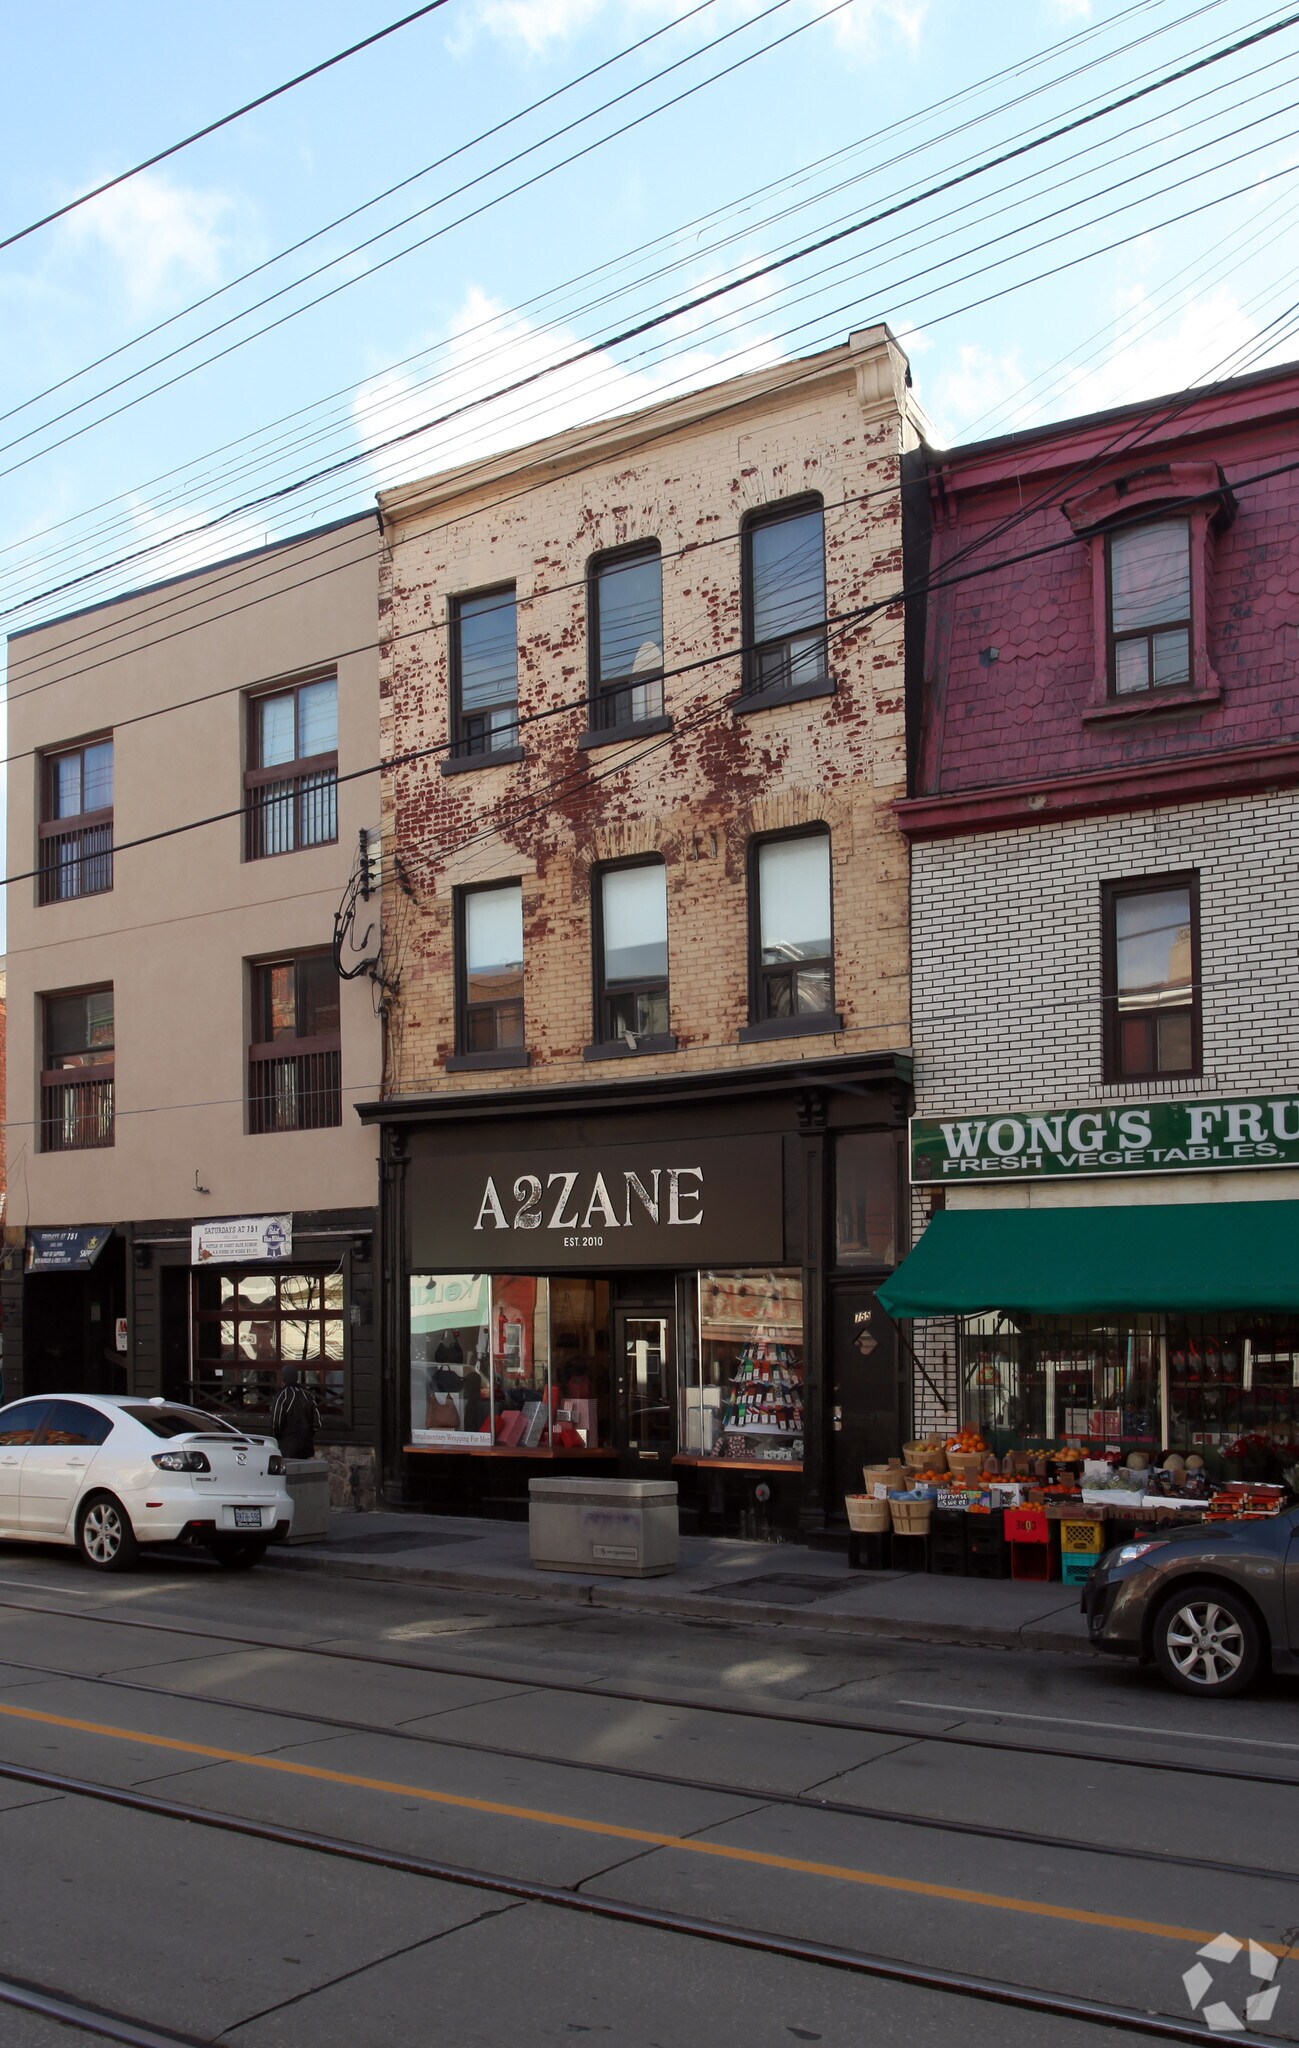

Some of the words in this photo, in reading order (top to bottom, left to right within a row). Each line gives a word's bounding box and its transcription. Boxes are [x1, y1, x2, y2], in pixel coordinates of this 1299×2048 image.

[940, 1109, 1153, 1158] WONG'S
[1185, 1100, 1299, 1146] FRU
[942, 1154, 1042, 1173] FRESH
[1056, 1142, 1286, 1168] VEGETABLES,
[473, 1166, 704, 1230] A2ZANE
[67, 1232, 78, 1240] 751
[204, 1226, 236, 1235] SATURDAYS
[238, 1225, 246, 1233] AT
[247, 1225, 258, 1233] 751
[564, 1237, 581, 1247] EST.
[582, 1236, 603, 1247] 2010
[854, 1310, 872, 1323] 755
[937, 1493, 968, 1501] Harvest
